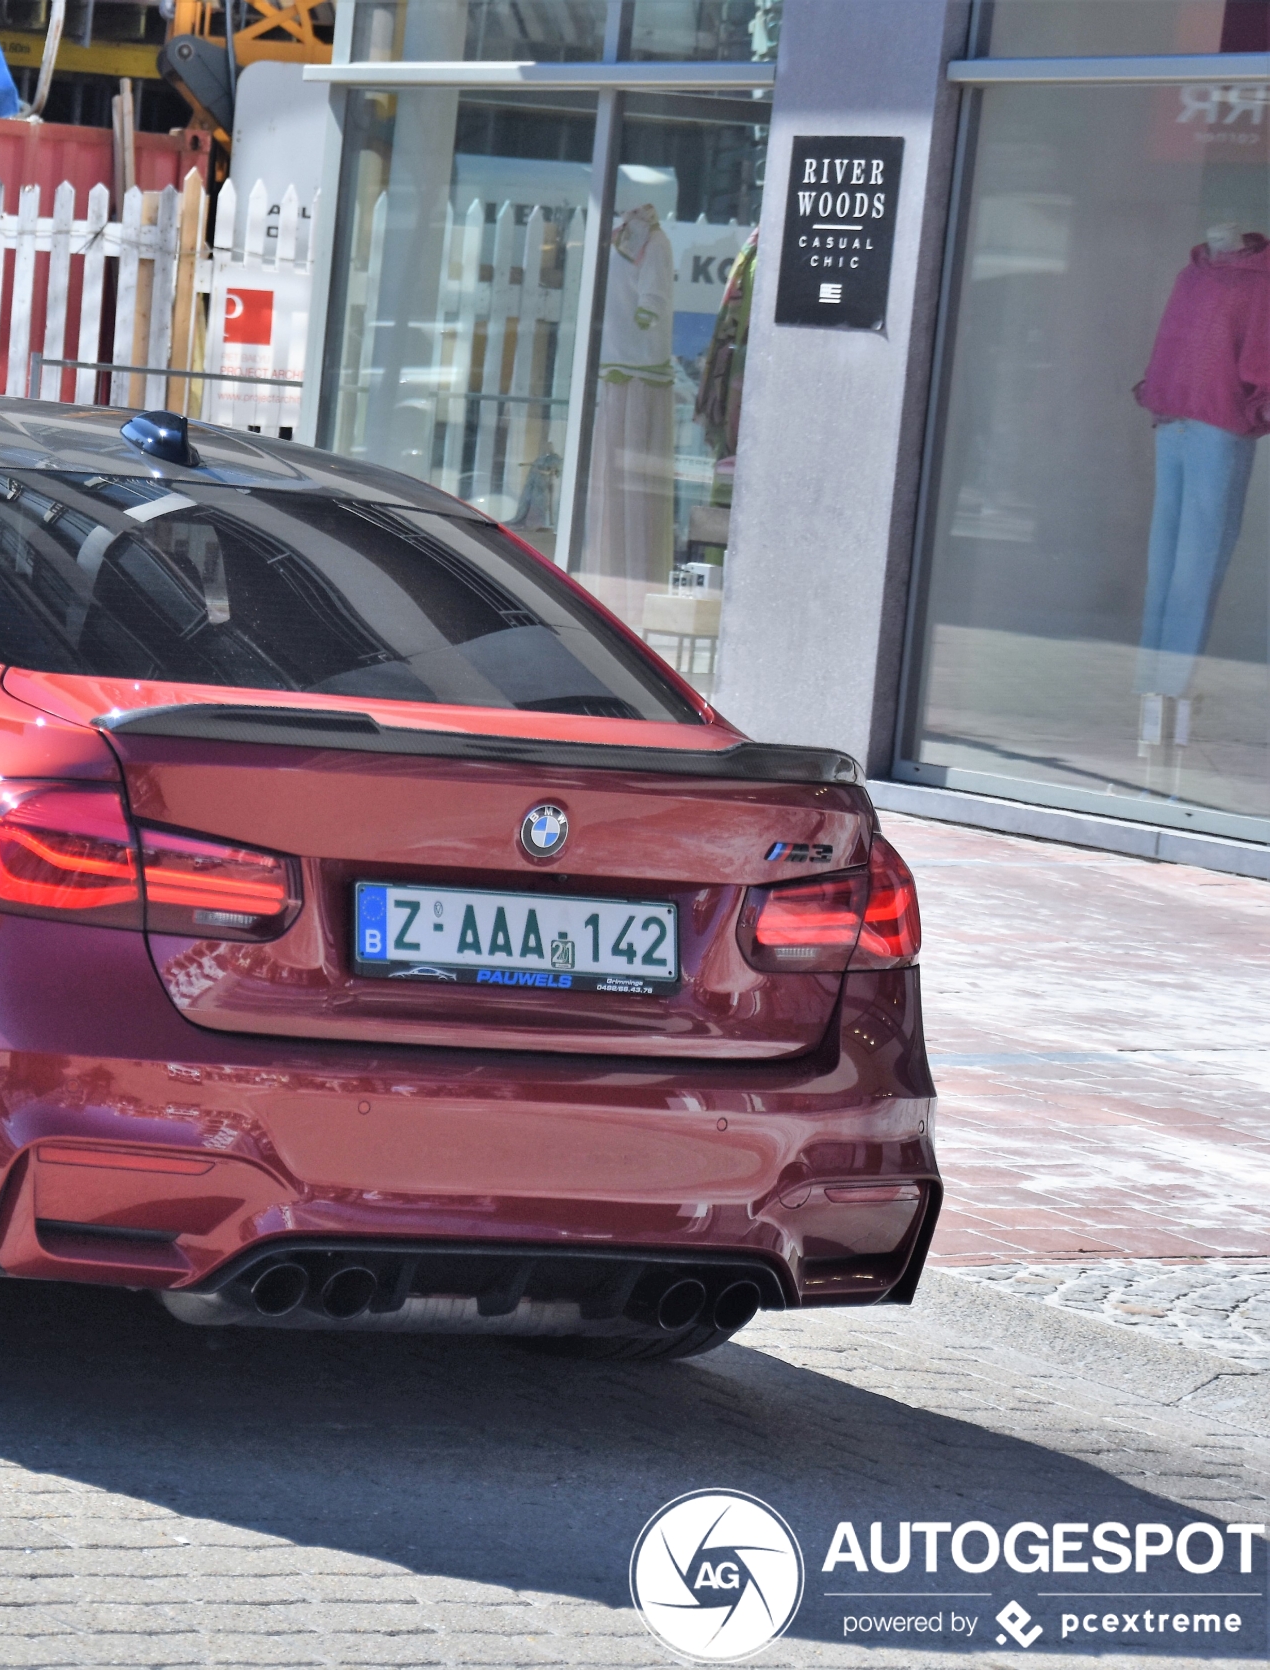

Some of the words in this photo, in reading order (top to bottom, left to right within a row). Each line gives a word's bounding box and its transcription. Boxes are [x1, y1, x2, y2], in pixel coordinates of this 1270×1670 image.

[802, 158, 885, 185] RIVER
[797, 191, 885, 219] WOODS
[798, 236, 874, 250] CASUAL
[810, 255, 860, 268] CHIC
[219, 366, 269, 379] PROJECT
[529, 806, 567, 824] BMW
[764, 842, 833, 863] M3
[364, 929, 382, 954] B
[476, 969, 573, 988] PAUWELS
